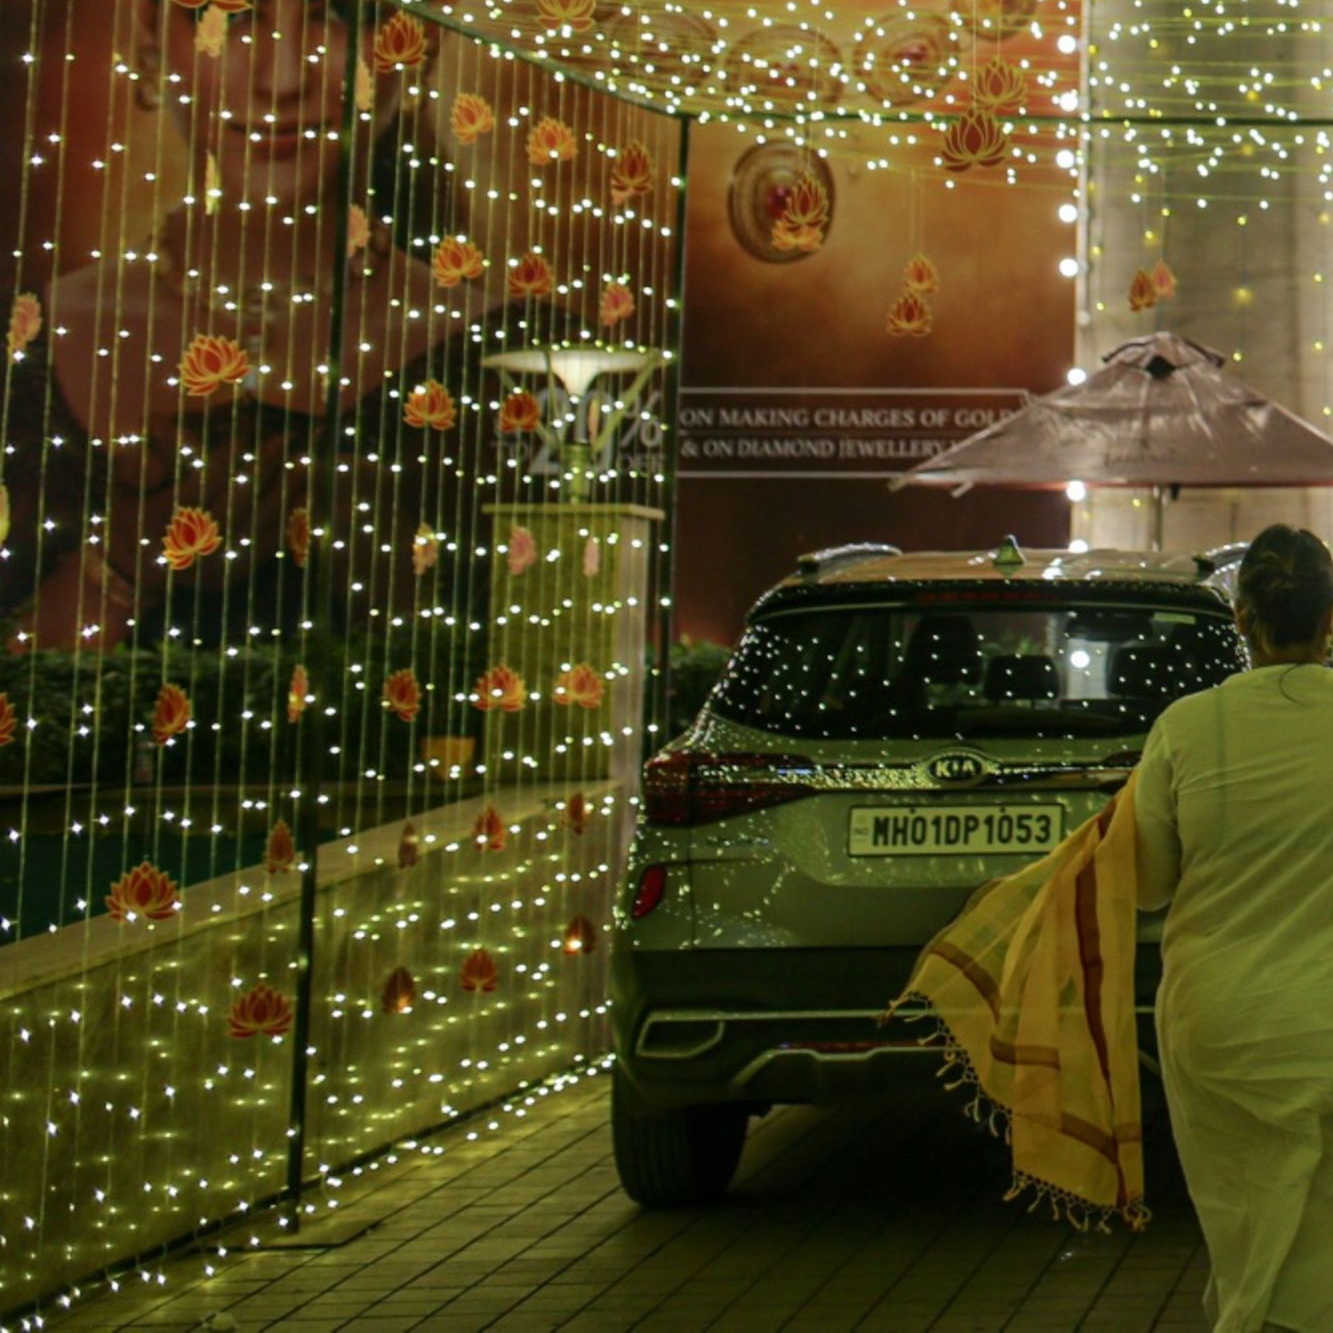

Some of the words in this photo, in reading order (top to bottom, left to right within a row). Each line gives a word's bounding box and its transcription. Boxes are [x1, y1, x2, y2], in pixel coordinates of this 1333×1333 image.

[680, 408, 713, 428] ON
[719, 409, 809, 428] MAKING
[813, 409, 915, 428] CHARGES
[919, 409, 949, 428] OF
[680, 439, 698, 457] &
[702, 439, 733, 457] ON
[736, 439, 835, 458] DIAMOND
[837, 439, 944, 459] JEWELLERY
[935, 760, 977, 778] KIA
[872, 813, 1053, 847] MH01DP1053
